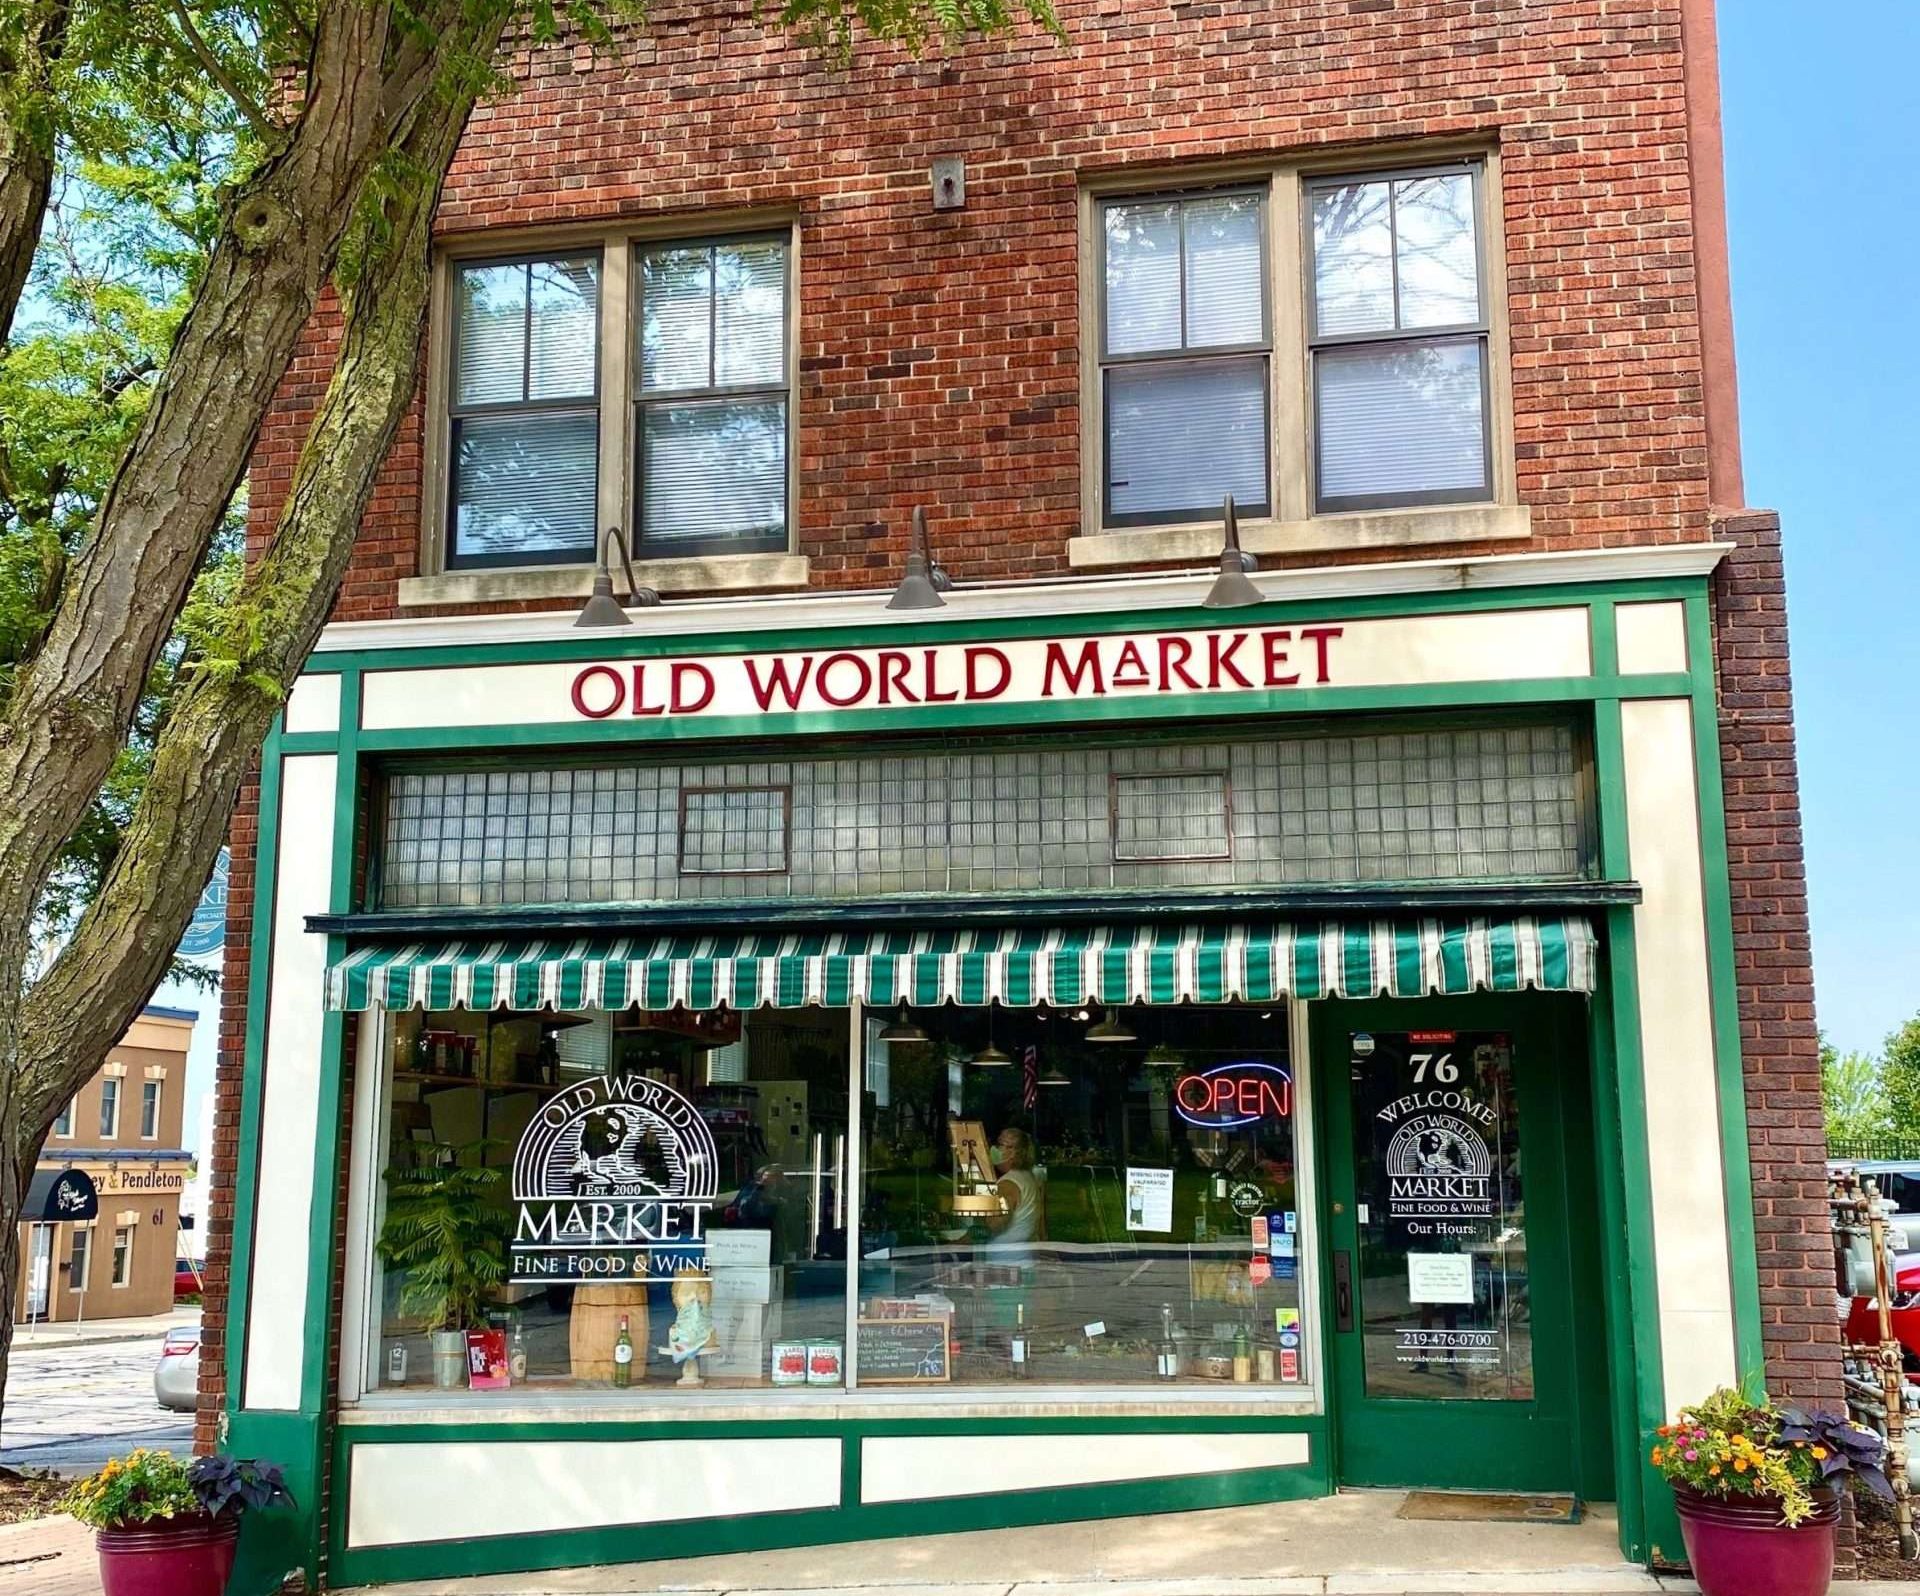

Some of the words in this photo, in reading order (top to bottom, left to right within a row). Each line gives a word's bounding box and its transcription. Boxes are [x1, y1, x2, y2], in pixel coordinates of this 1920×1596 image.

[571, 663, 715, 719] OLD
[743, 647, 1012, 712] WORLD
[1041, 627, 1344, 697] MARKET
[1409, 1053, 1459, 1084] 76
[543, 1087, 596, 1128] OLD
[601, 1074, 692, 1128] WORLD
[1177, 1075, 1288, 1116] OPEN
[1376, 1090, 1497, 1126] WELCOME
[1399, 1119, 1425, 1142] OLD
[1426, 1114, 1475, 1142] WORLD
[121, 1171, 182, 1188] Pendleton
[1390, 1177, 1489, 1197] MARKET
[586, 1186, 608, 1196] EST.
[613, 1184, 641, 1196] 2000
[152, 1208, 163, 1225] 61
[1391, 1203, 1414, 1212] FINE
[1418, 1203, 1448, 1213] FOOD
[1450, 1203, 1460, 1212] &
[1462, 1203, 1491, 1213] WINE
[513, 1202, 713, 1241] MARKET
[1408, 1222, 1433, 1234] Our
[1436, 1222, 1477, 1235] Hours:
[513, 1255, 559, 1273] FINE
[567, 1255, 626, 1273] FOOD
[632, 1255, 650, 1272] &
[655, 1254, 712, 1273] WINE
[1404, 1333, 1492, 1346] 219-476-0700
